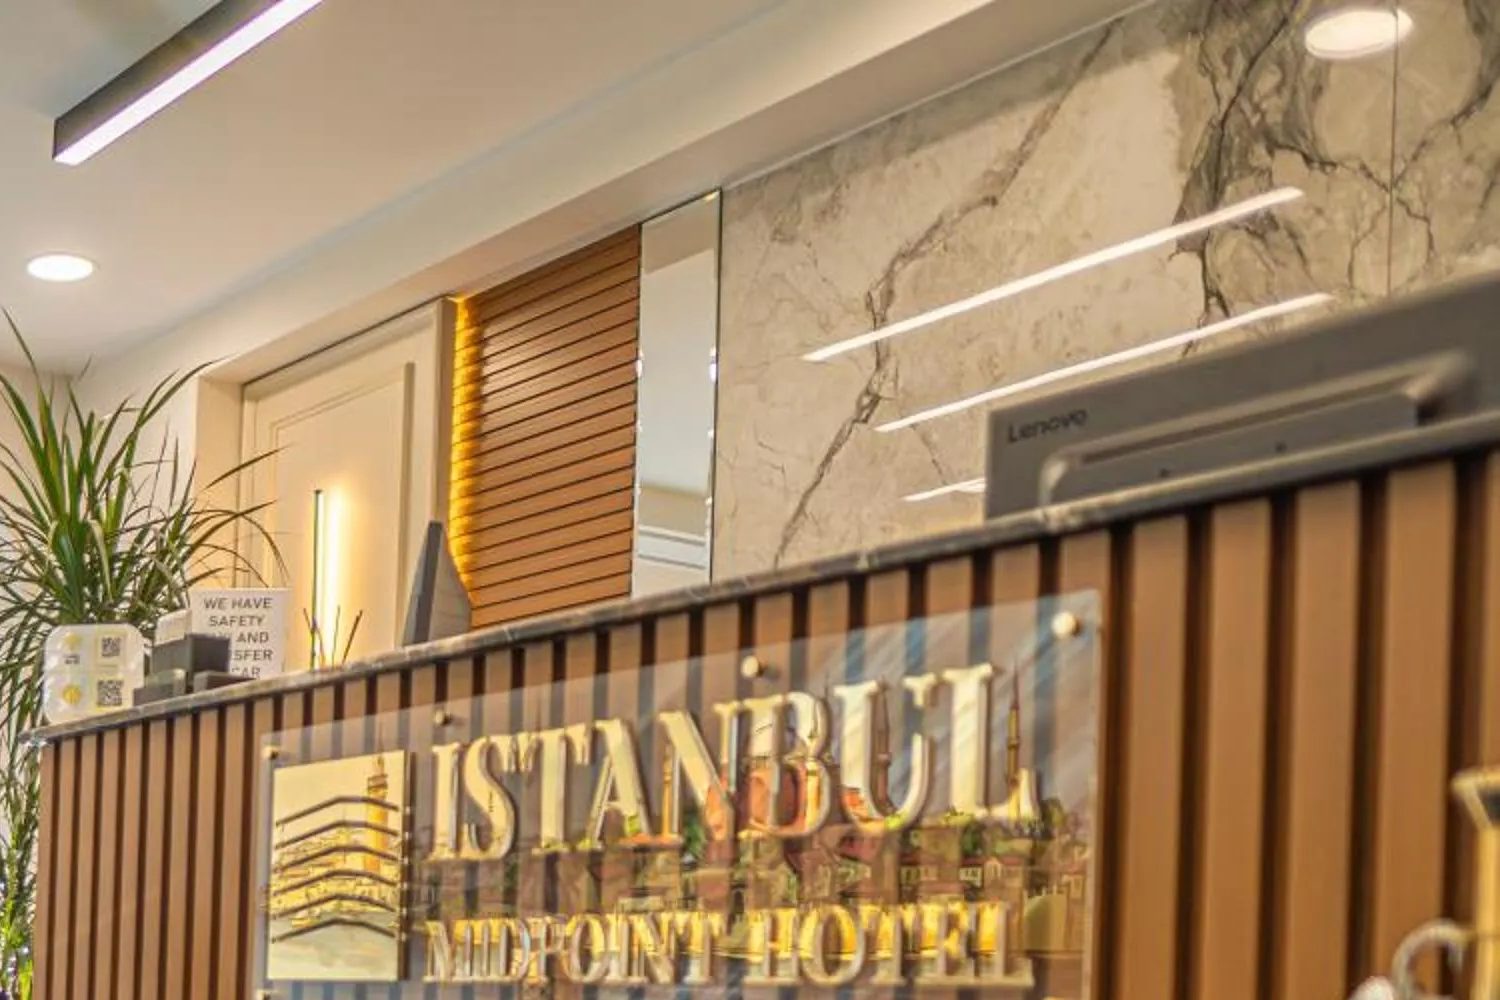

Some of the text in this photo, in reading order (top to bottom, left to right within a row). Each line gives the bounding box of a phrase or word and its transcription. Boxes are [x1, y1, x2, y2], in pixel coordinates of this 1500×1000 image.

[1007, 409, 1088, 444] Lenovo
[204, 597, 274, 609] WE HAVE
[209, 615, 265, 627] SAFETY
[236, 631, 269, 643] AND
[232, 649, 274, 661] SFER
[426, 663, 1040, 861] ISTANBUL
[423, 902, 1034, 987] MIDPOINT HOTEL
